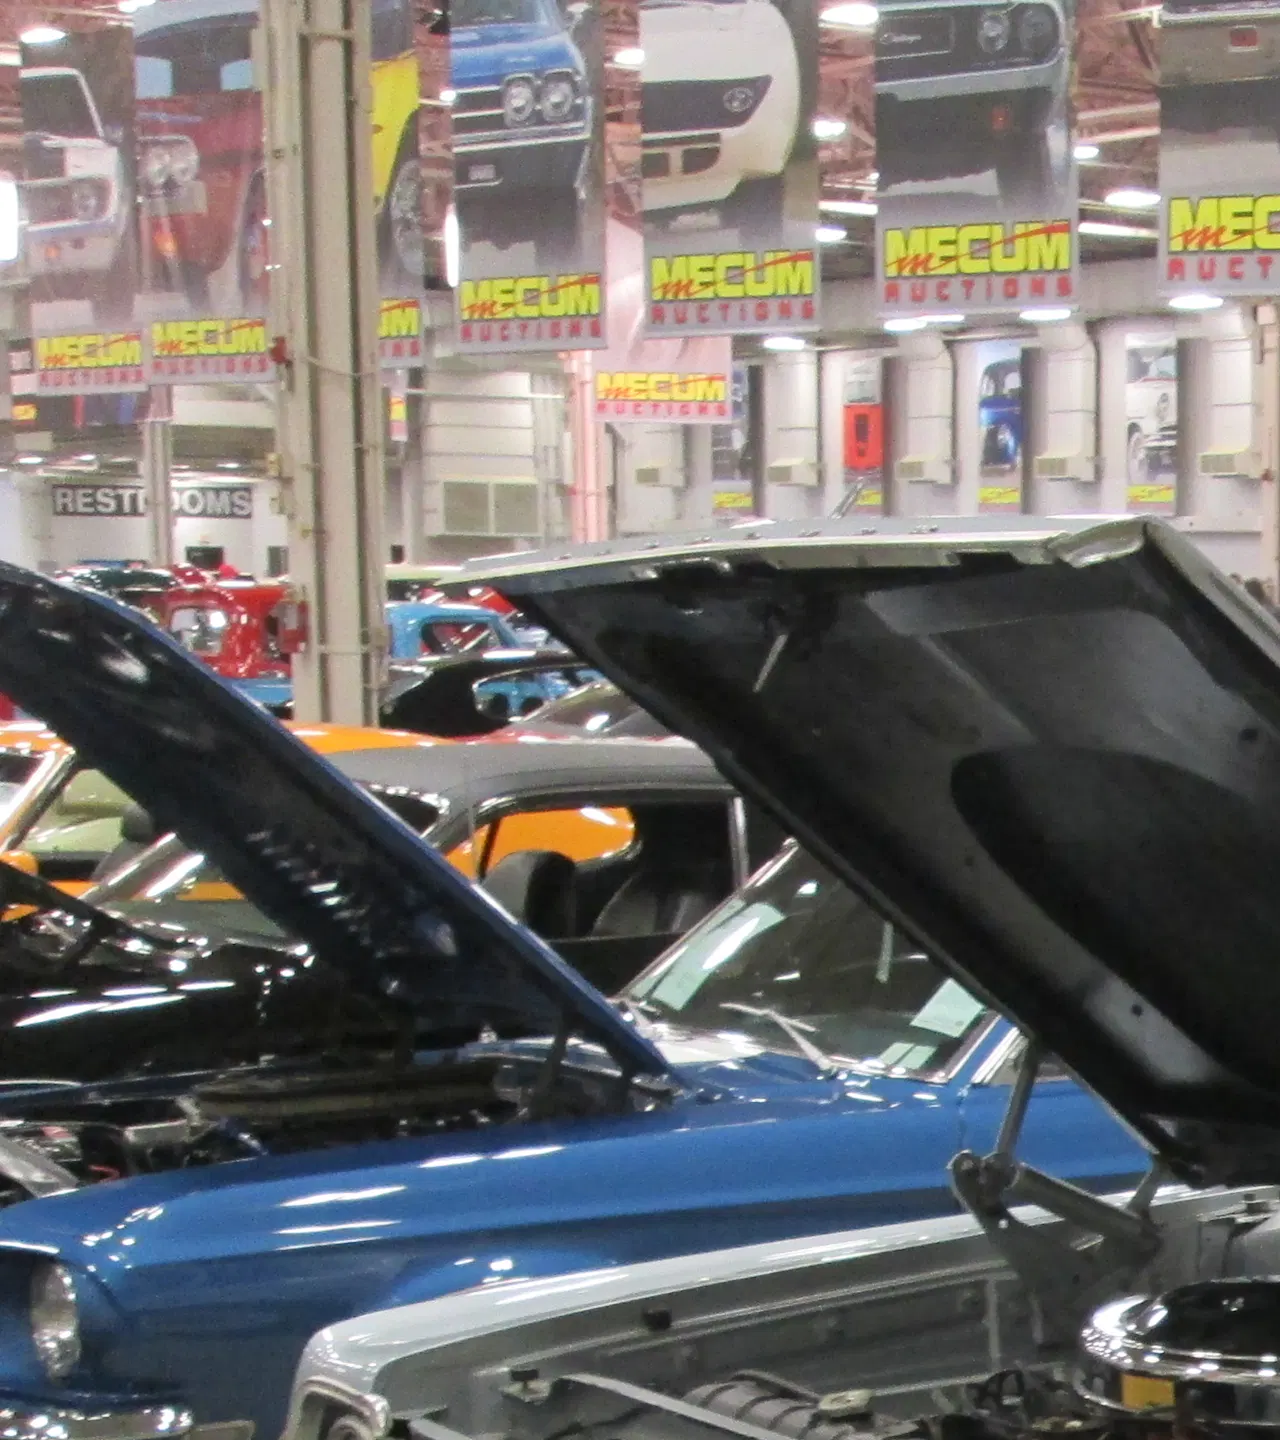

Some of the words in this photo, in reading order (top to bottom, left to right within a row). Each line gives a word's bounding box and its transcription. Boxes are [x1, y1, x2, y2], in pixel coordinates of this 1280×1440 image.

[884, 219, 1072, 279] MECUM
[650, 249, 815, 301] MECUM
[884, 275, 1073, 303] AUCTIONS
[460, 272, 600, 320] MECUM
[651, 300, 816, 326] AUCTIONS
[152, 318, 267, 358] MECUM
[461, 318, 601, 342] AUCTIONS
[37, 332, 142, 370] MECUM
[597, 371, 727, 402] MECUM
